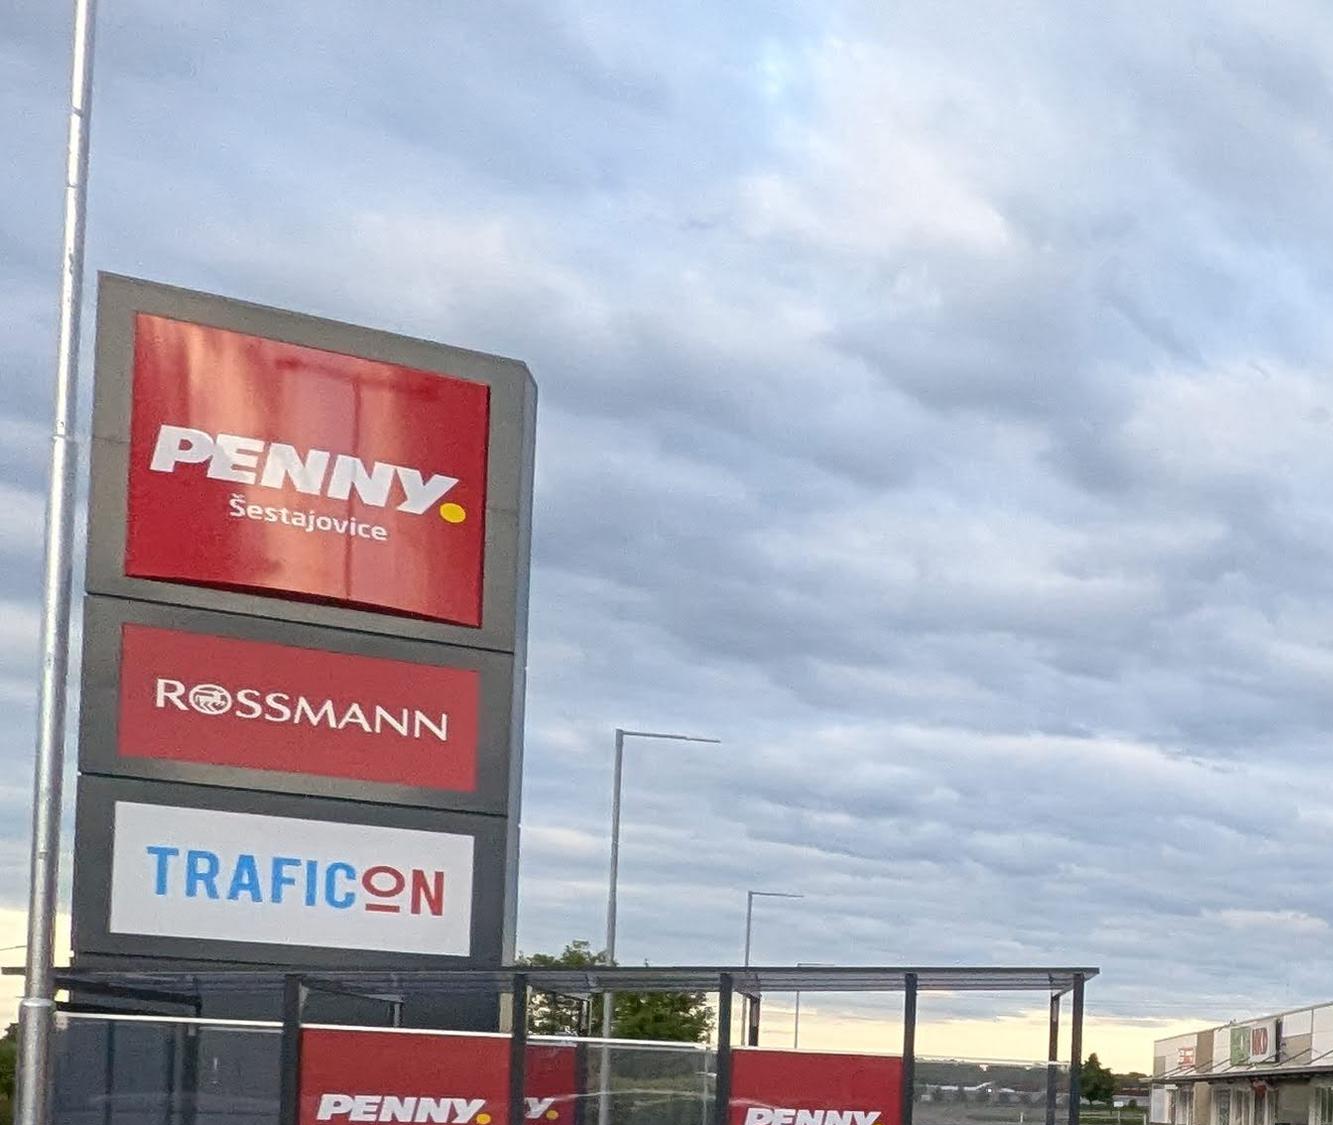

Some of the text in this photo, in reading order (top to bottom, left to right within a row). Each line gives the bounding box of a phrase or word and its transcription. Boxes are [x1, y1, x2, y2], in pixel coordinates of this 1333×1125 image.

[229, 492, 388, 541] Šestajovice
[156, 678, 448, 742] ROSSMANN
[146, 846, 445, 917] TRAFICON
